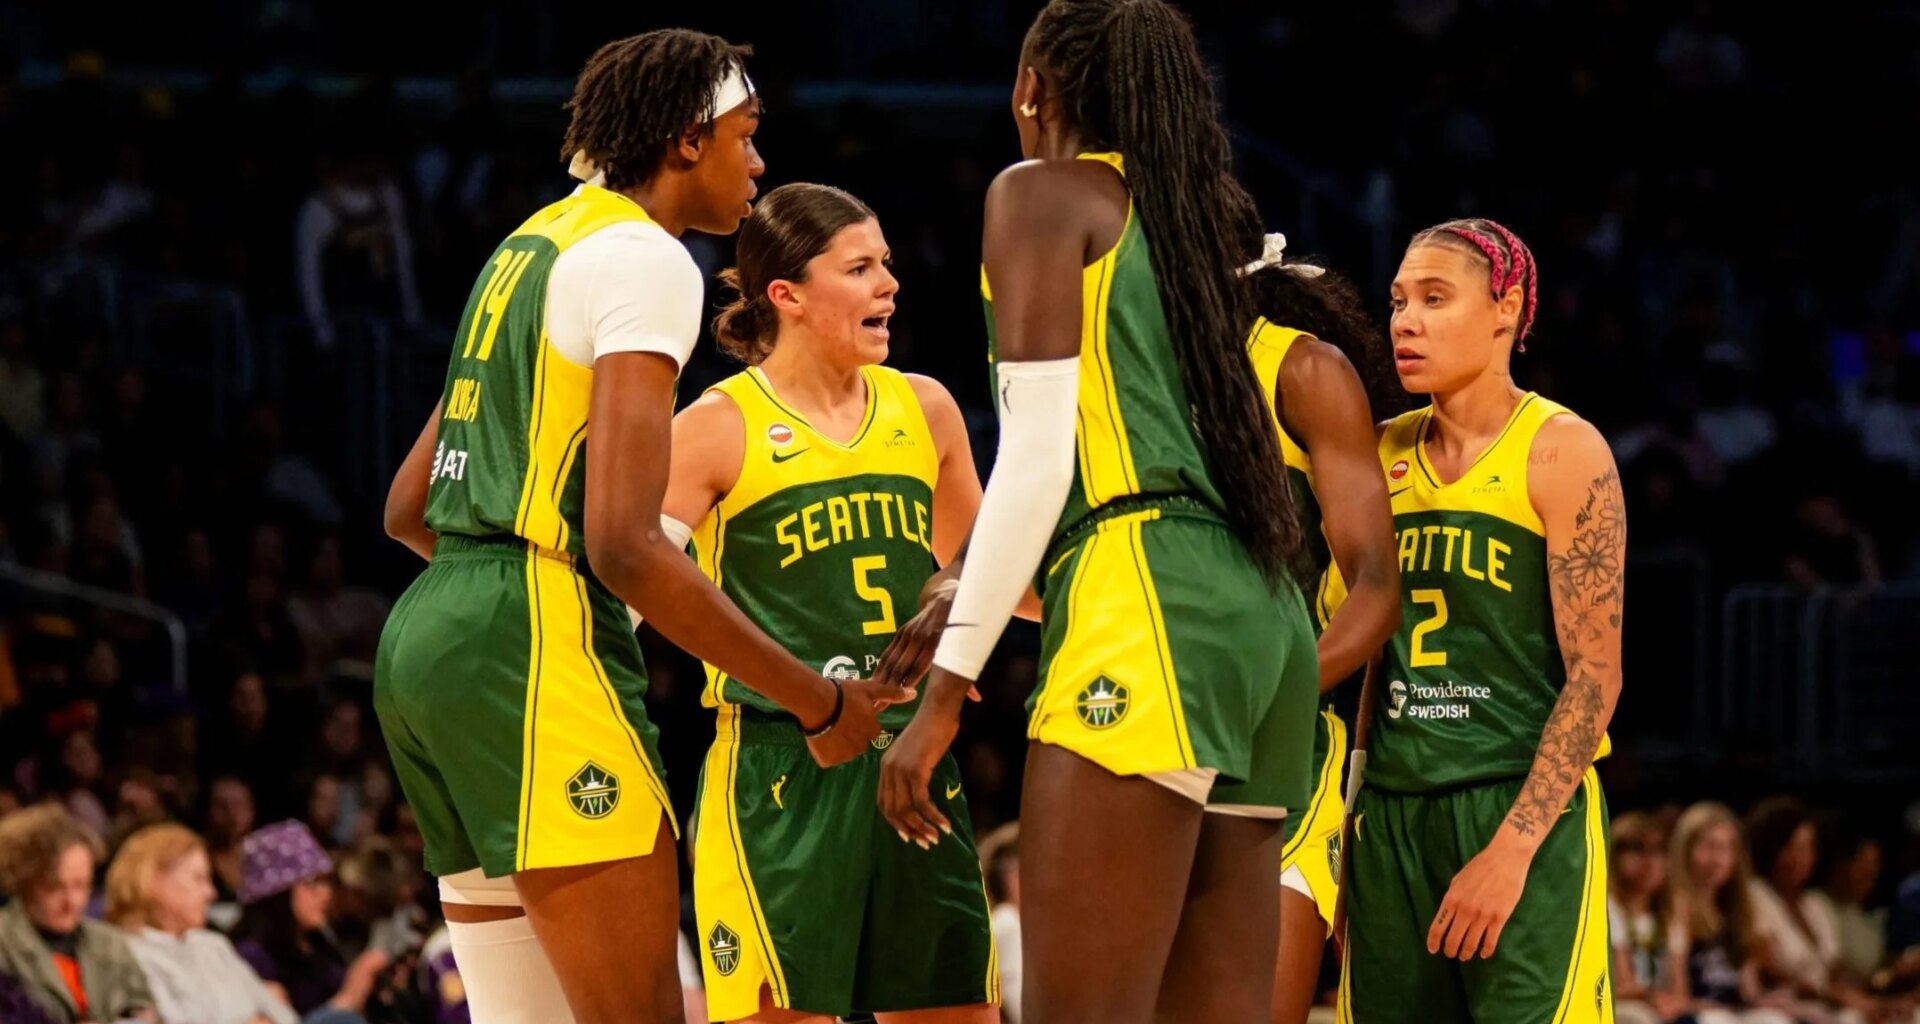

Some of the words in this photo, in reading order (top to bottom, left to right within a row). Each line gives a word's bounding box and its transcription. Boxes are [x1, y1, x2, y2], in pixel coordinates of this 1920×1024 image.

[463, 249, 537, 361] 14
[775, 492, 932, 569] SEATTLE
[1395, 525, 1512, 592] ATTLE
[852, 554, 897, 636] 5
[1410, 588, 1449, 668] 2
[1408, 704, 1470, 719] SWEDISH
[1409, 680, 1491, 699] Providence
